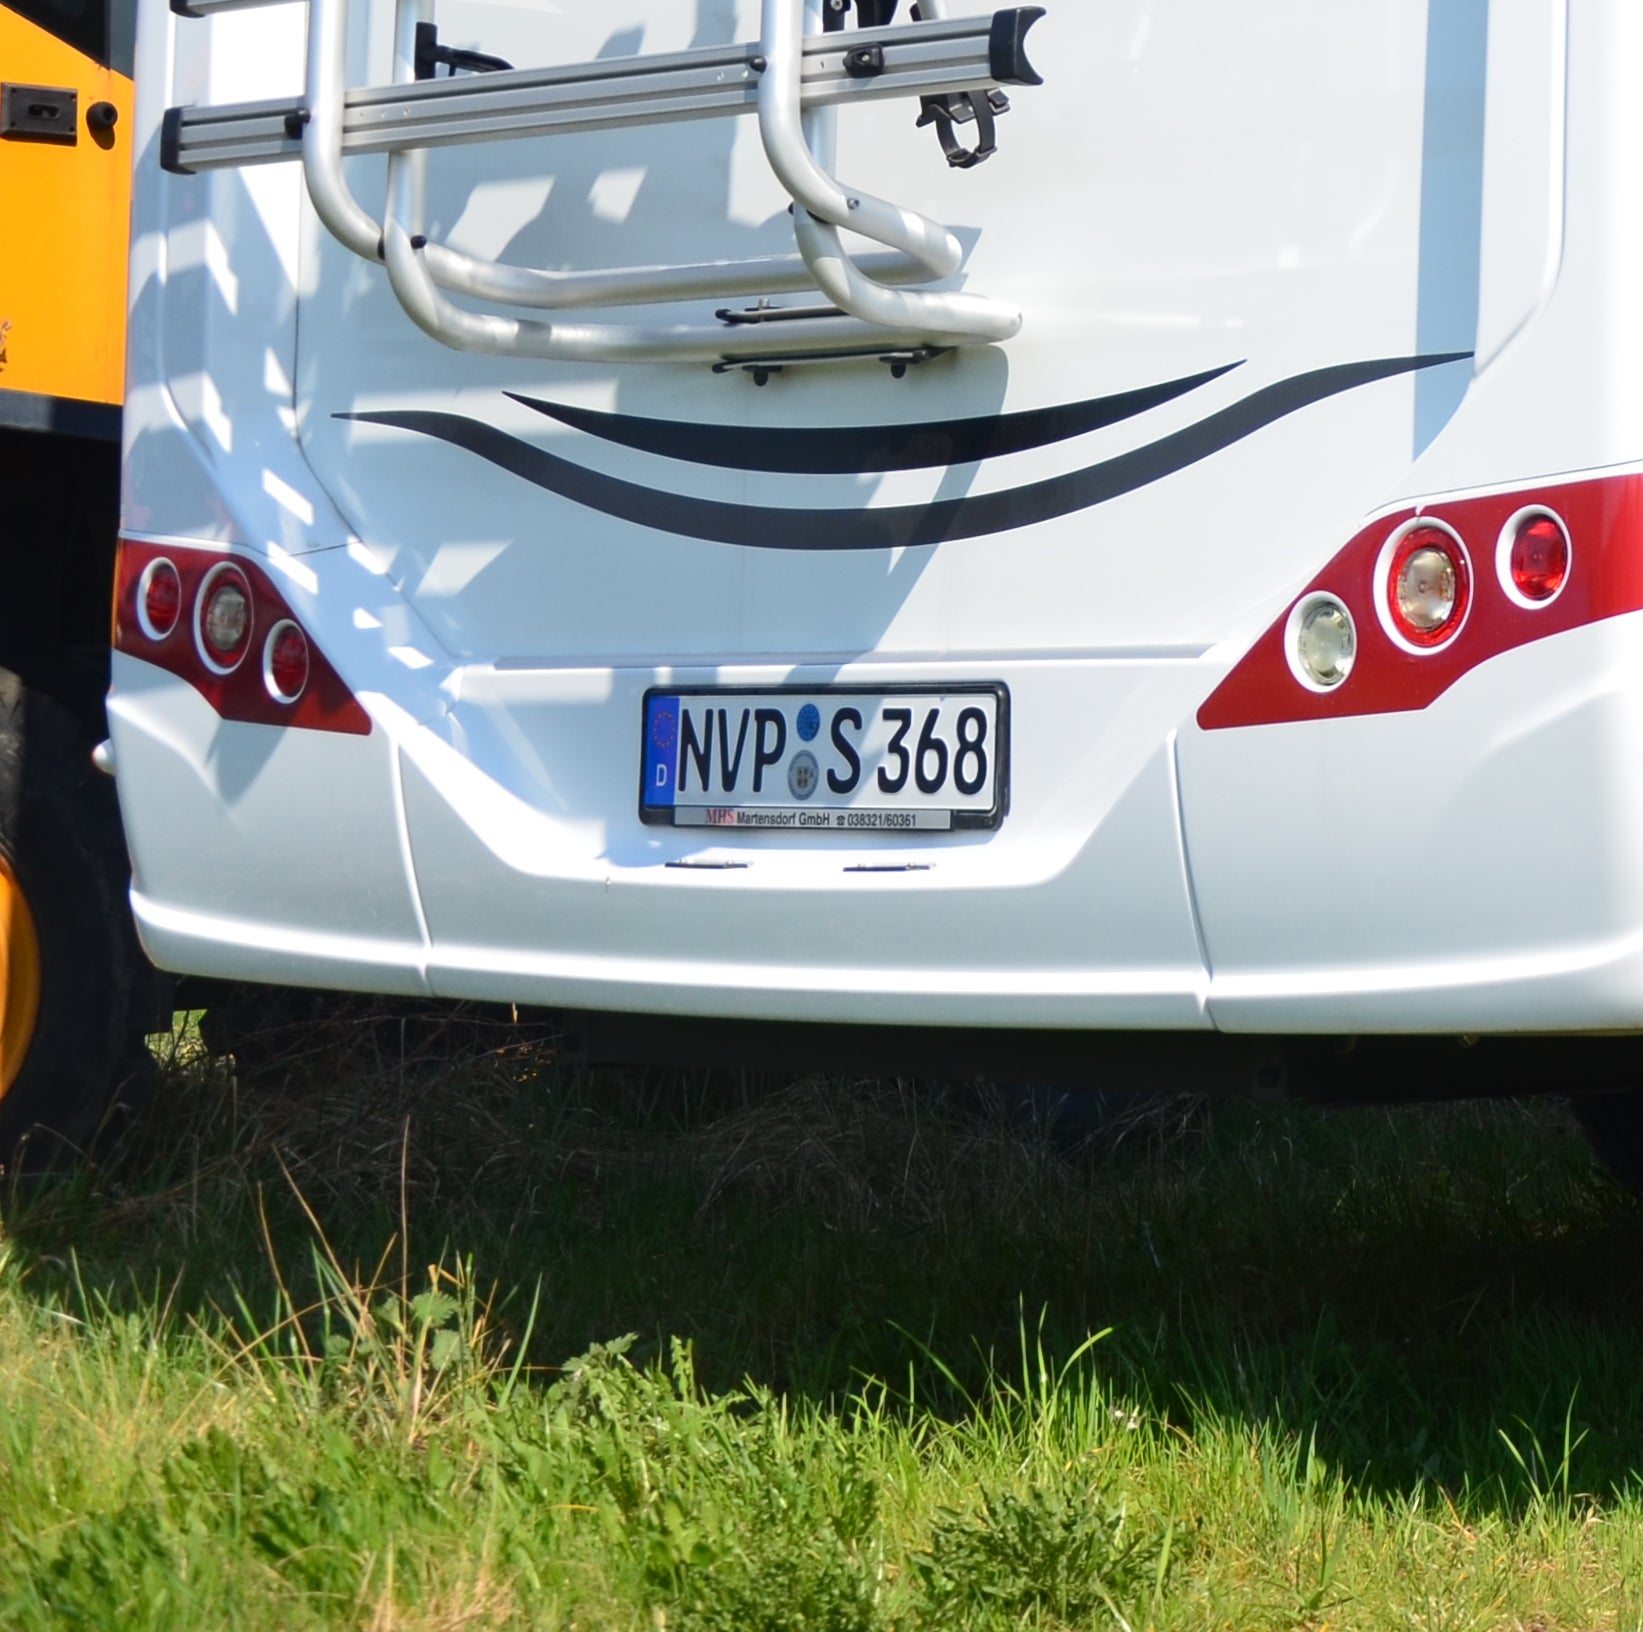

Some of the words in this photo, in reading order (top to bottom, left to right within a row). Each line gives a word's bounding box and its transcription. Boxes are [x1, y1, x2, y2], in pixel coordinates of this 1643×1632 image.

[677, 707, 787, 793] NVP
[826, 707, 863, 795] S
[876, 707, 988, 795] 368
[655, 764, 667, 787] D
[705, 808, 735, 825] MHS
[736, 810, 796, 826] Martensdorf
[799, 812, 830, 827] GmbH
[847, 814, 917, 828] 038321/60361
